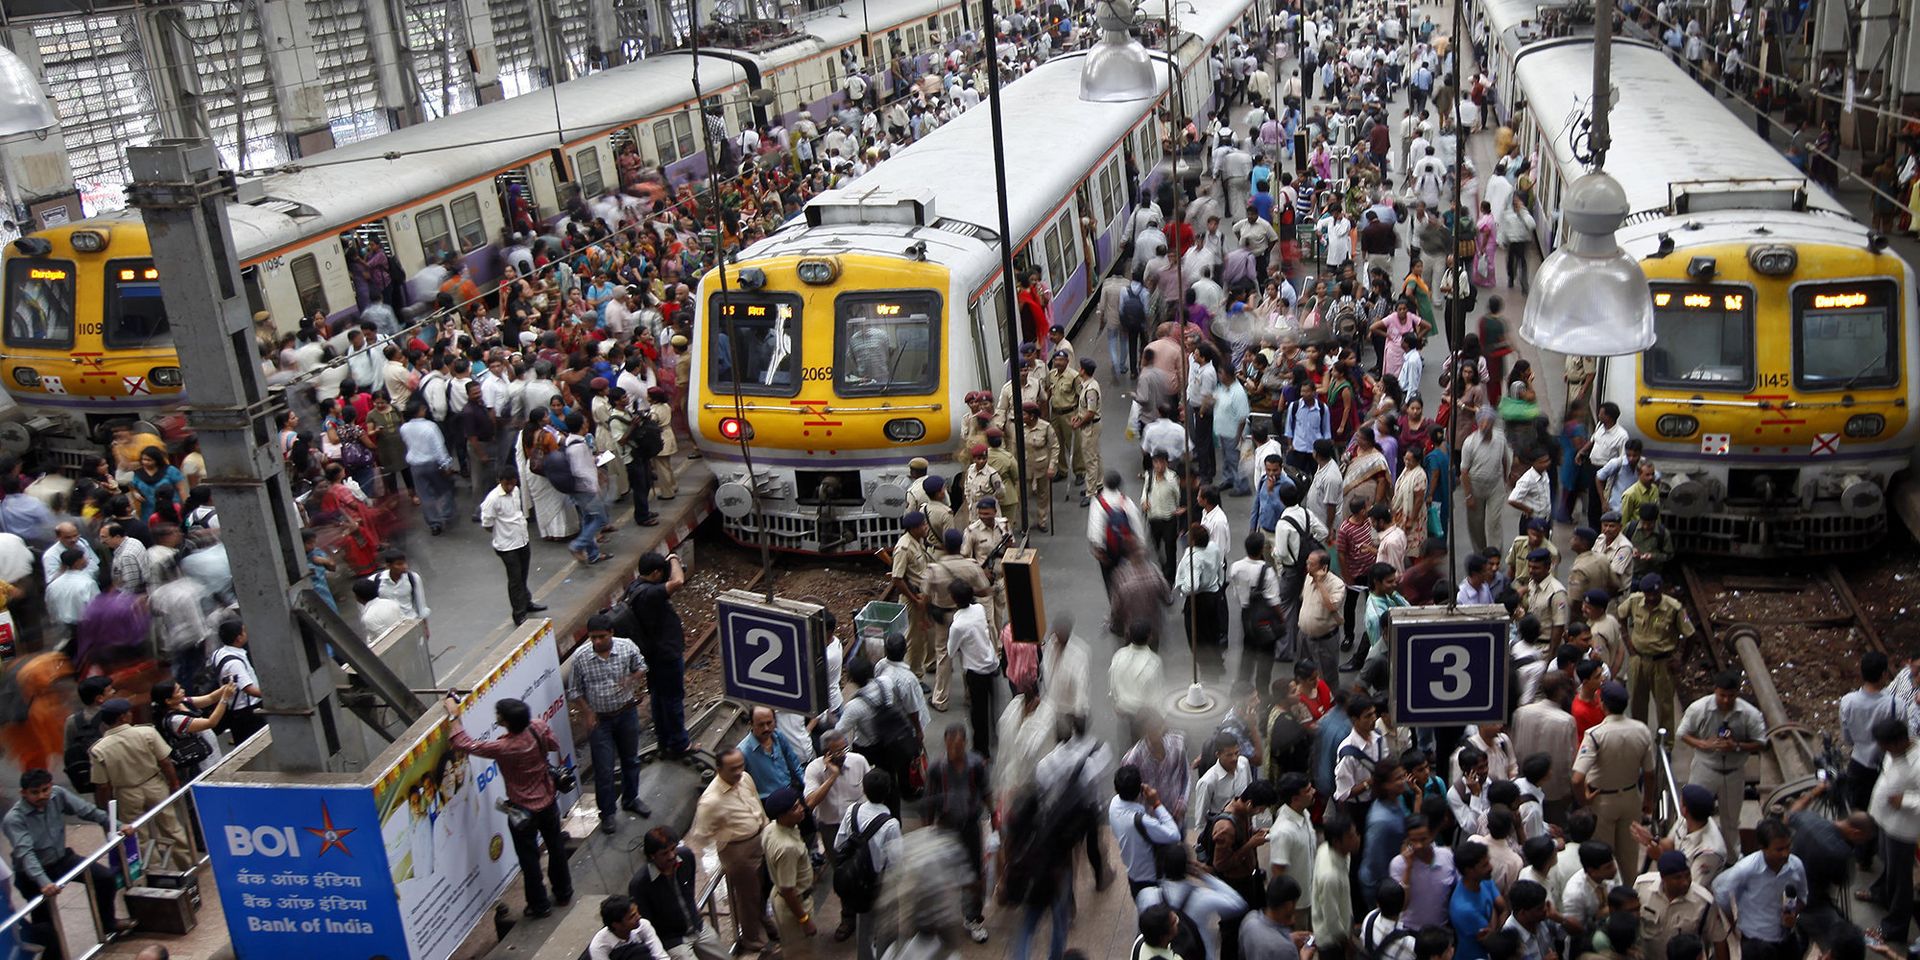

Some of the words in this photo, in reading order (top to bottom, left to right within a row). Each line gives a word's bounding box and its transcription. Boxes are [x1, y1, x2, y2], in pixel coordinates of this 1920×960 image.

[262, 256, 284, 272] 1109C
[79, 323, 103, 335] 1109
[802, 367, 833, 381] 2069
[1759, 373, 1789, 388] 1145
[745, 628, 785, 685] 2
[1429, 645, 1472, 701] 3
[477, 760, 498, 792] BOI
[224, 825, 300, 857] BOI
[313, 872, 361, 888] इंडिया
[319, 895, 367, 912] इंडिया
[247, 916, 298, 932] Bank
[301, 918, 320, 933] of
[325, 918, 374, 934] India
